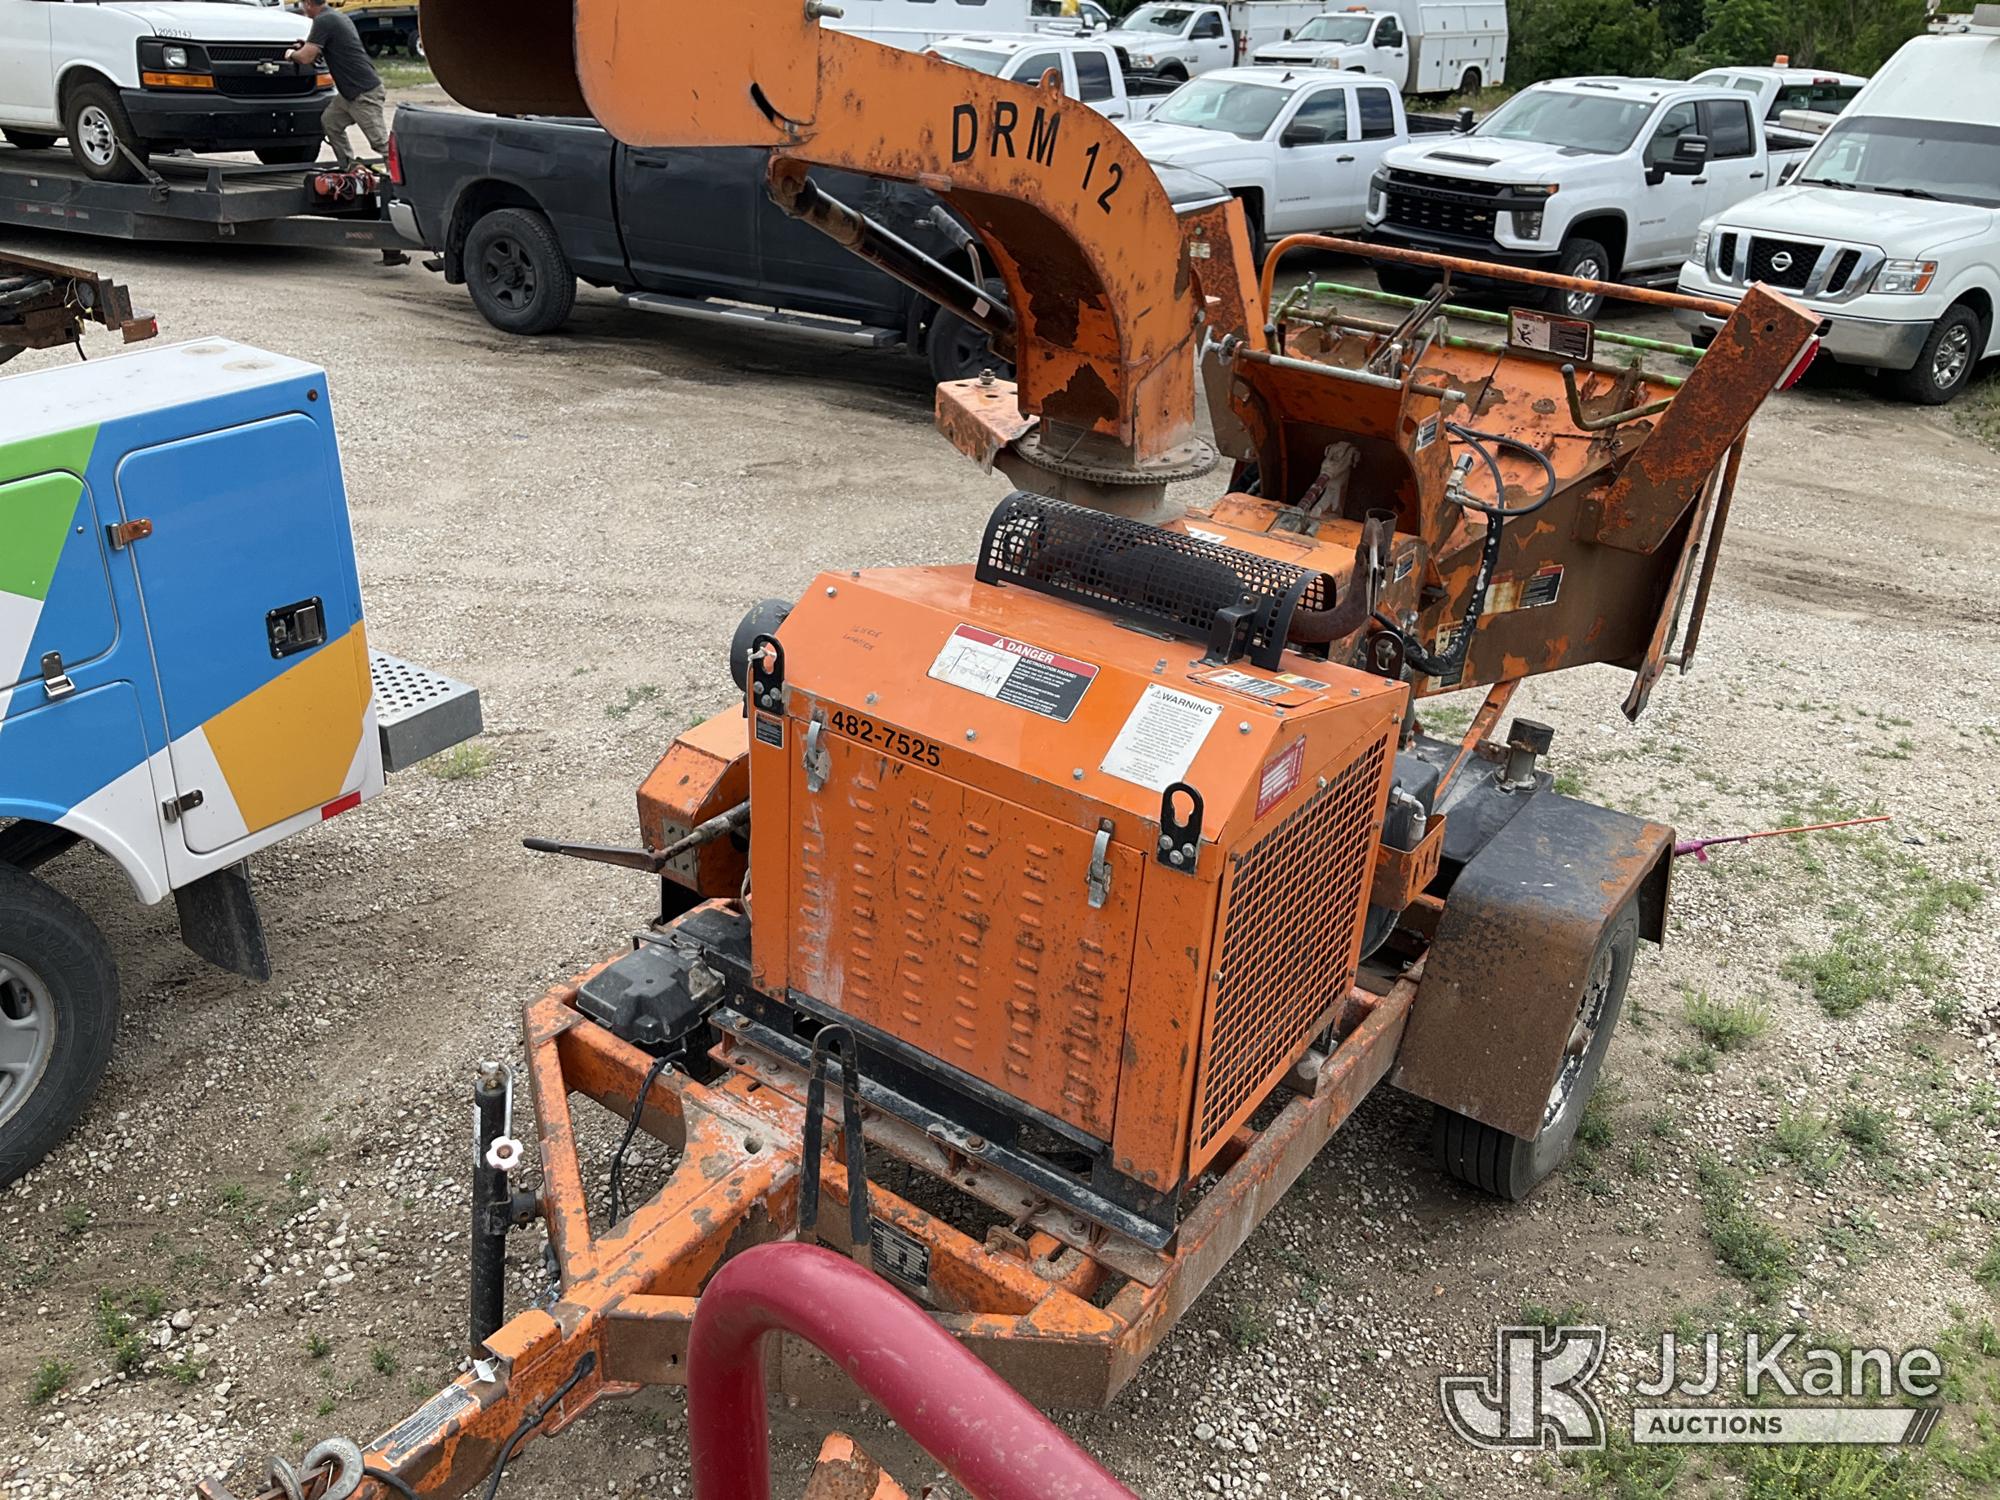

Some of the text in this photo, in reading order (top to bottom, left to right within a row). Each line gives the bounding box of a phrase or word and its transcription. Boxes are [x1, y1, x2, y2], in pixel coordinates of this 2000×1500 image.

[952, 100, 1124, 215] DRM 12
[1006, 642, 1054, 663] DANGER
[1161, 692, 1213, 716] WARNING
[831, 710, 941, 768] 482-7525
